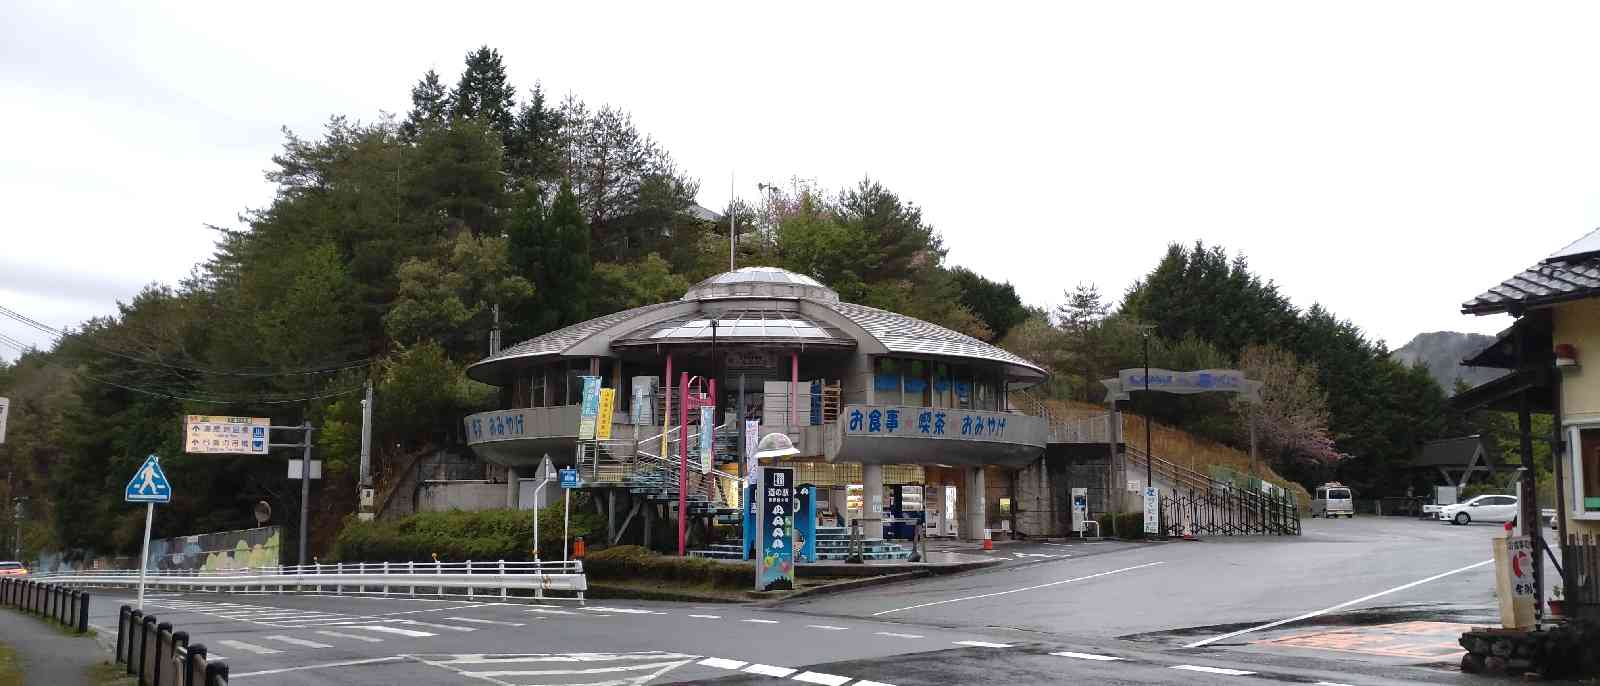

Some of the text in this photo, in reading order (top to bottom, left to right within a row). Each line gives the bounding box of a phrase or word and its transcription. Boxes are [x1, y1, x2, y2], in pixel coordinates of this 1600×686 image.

[849, 409, 1006, 435] お食事 喫茶 おみやげ
